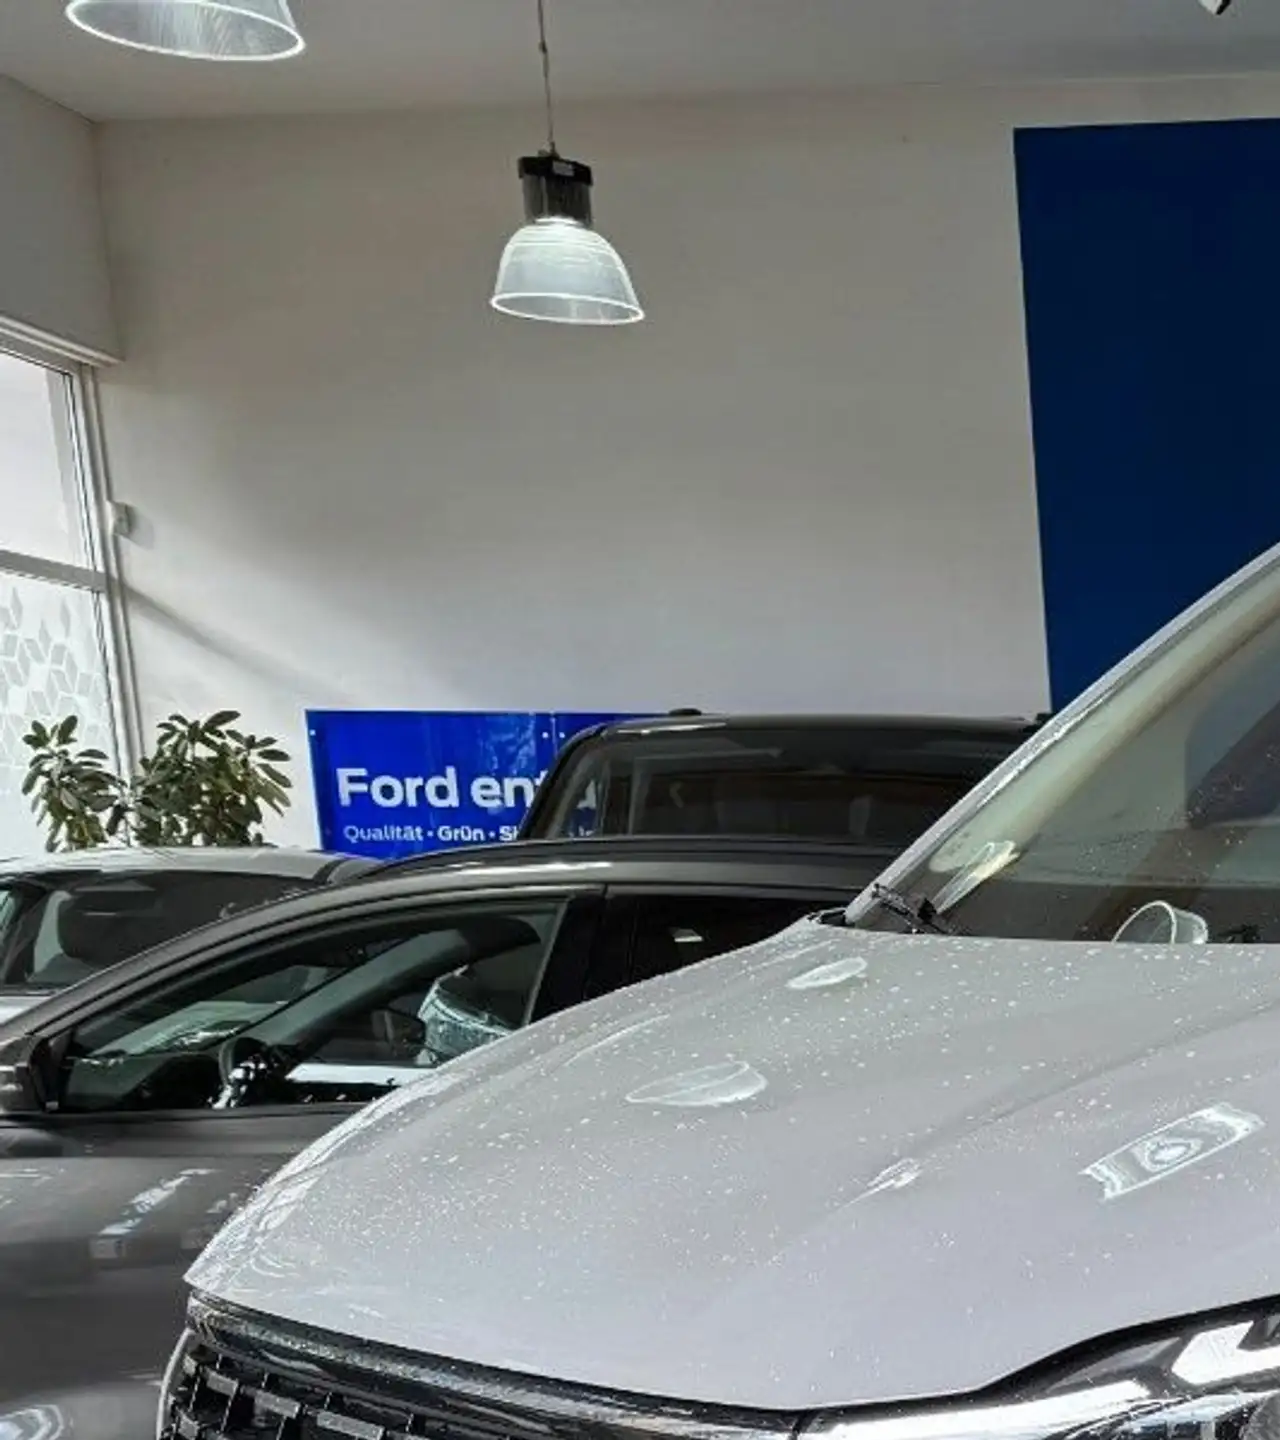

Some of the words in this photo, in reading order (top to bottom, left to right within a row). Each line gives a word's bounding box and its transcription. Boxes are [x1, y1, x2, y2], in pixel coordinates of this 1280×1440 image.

[336, 766, 460, 808] Ford
[343, 824, 424, 844] Qualität
[437, 825, 485, 842] Grün
